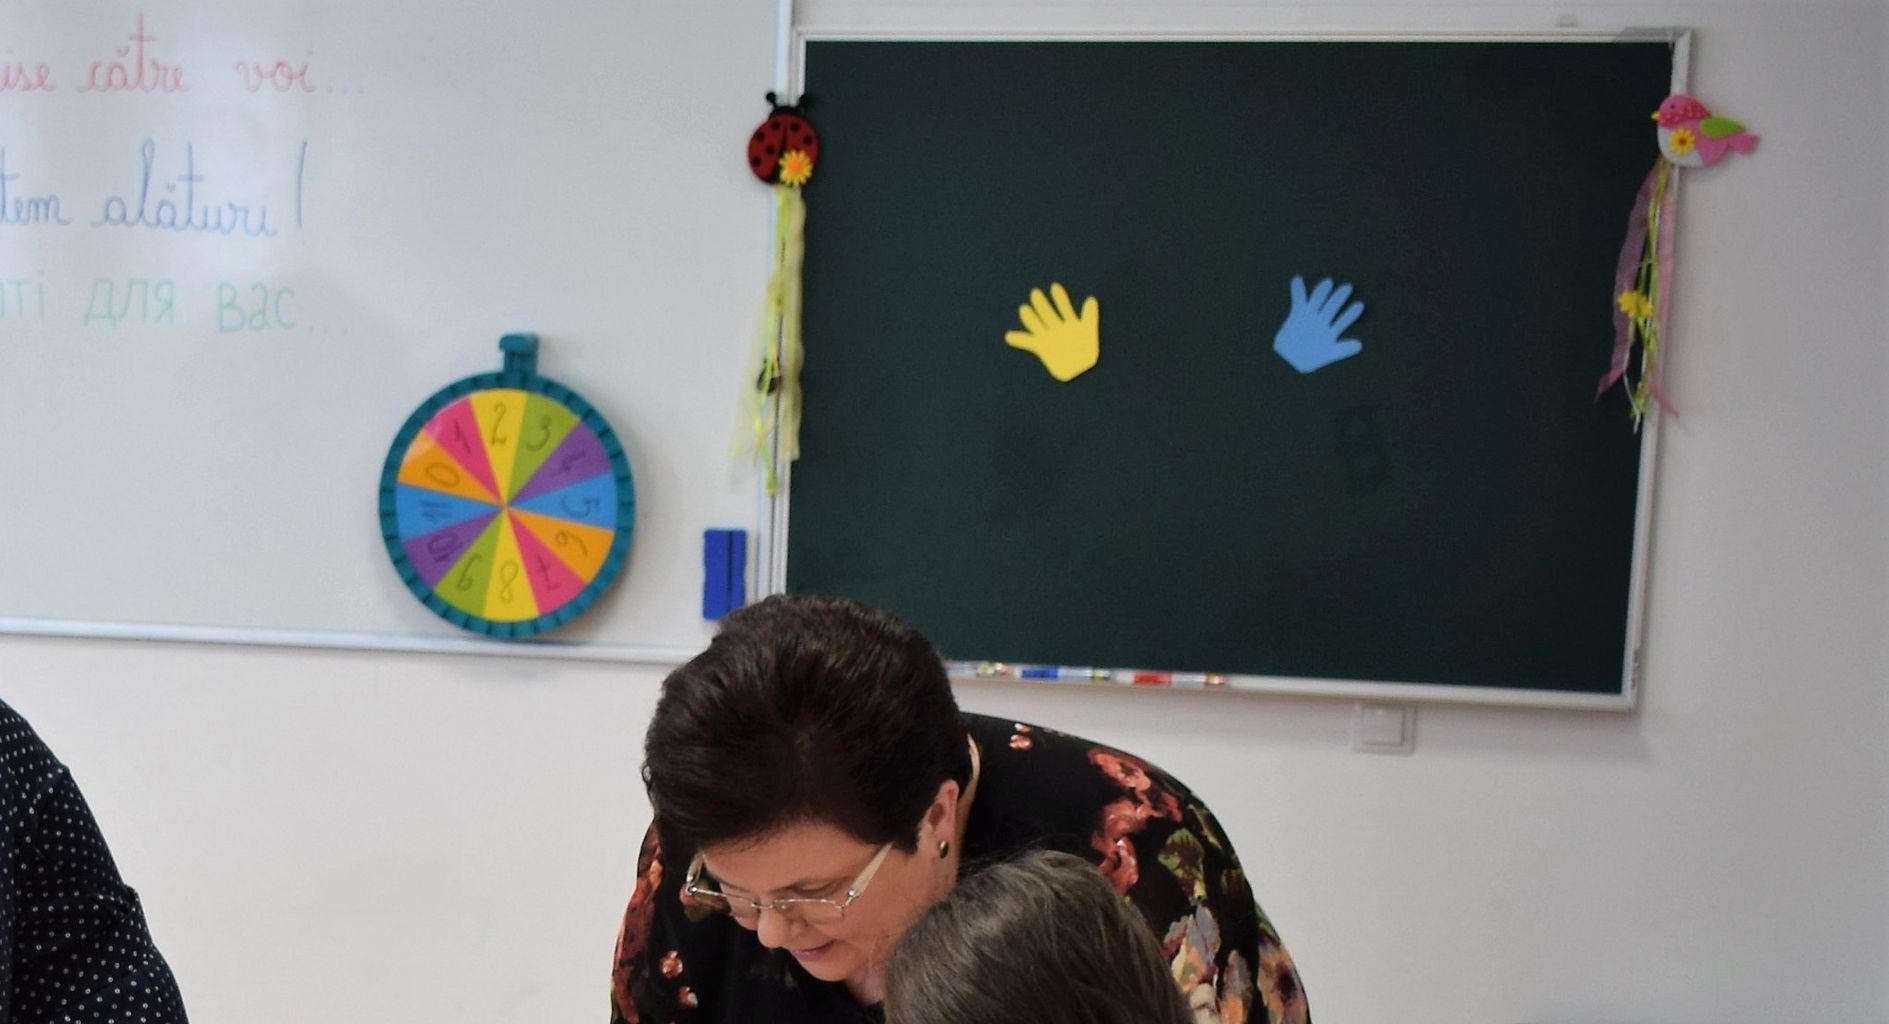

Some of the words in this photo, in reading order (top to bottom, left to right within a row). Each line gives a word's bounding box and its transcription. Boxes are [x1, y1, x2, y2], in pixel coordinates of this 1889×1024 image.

[76, 12, 193, 94] către
[84, 277, 177, 328] для
[453, 420, 472, 455] 1
[489, 402, 507, 446] 2
[526, 415, 553, 453] 3
[498, 559, 519, 604] 8
